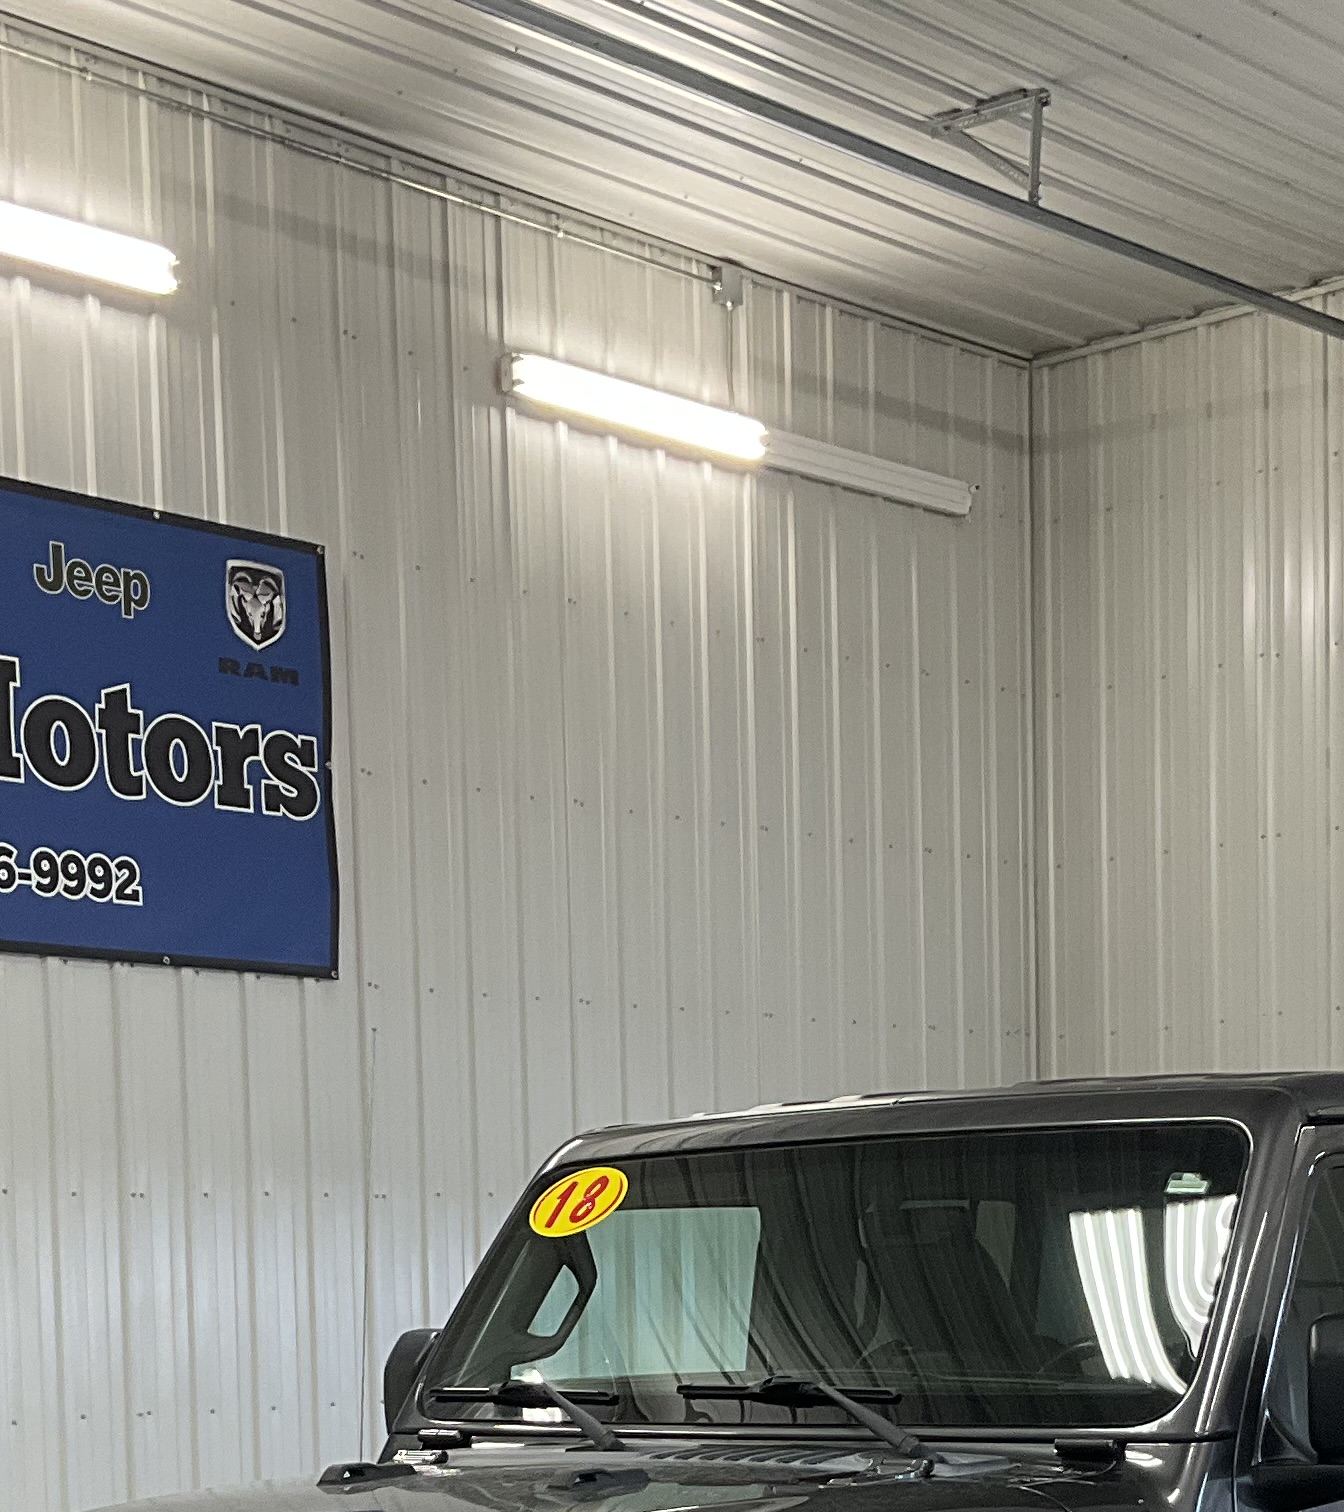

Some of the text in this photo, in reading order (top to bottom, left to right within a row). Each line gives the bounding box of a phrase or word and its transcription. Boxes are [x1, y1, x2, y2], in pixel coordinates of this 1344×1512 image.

[33, 540, 150, 619] Jeep
[218, 657, 299, 686] RAM
[545, 1175, 610, 1228] 18
